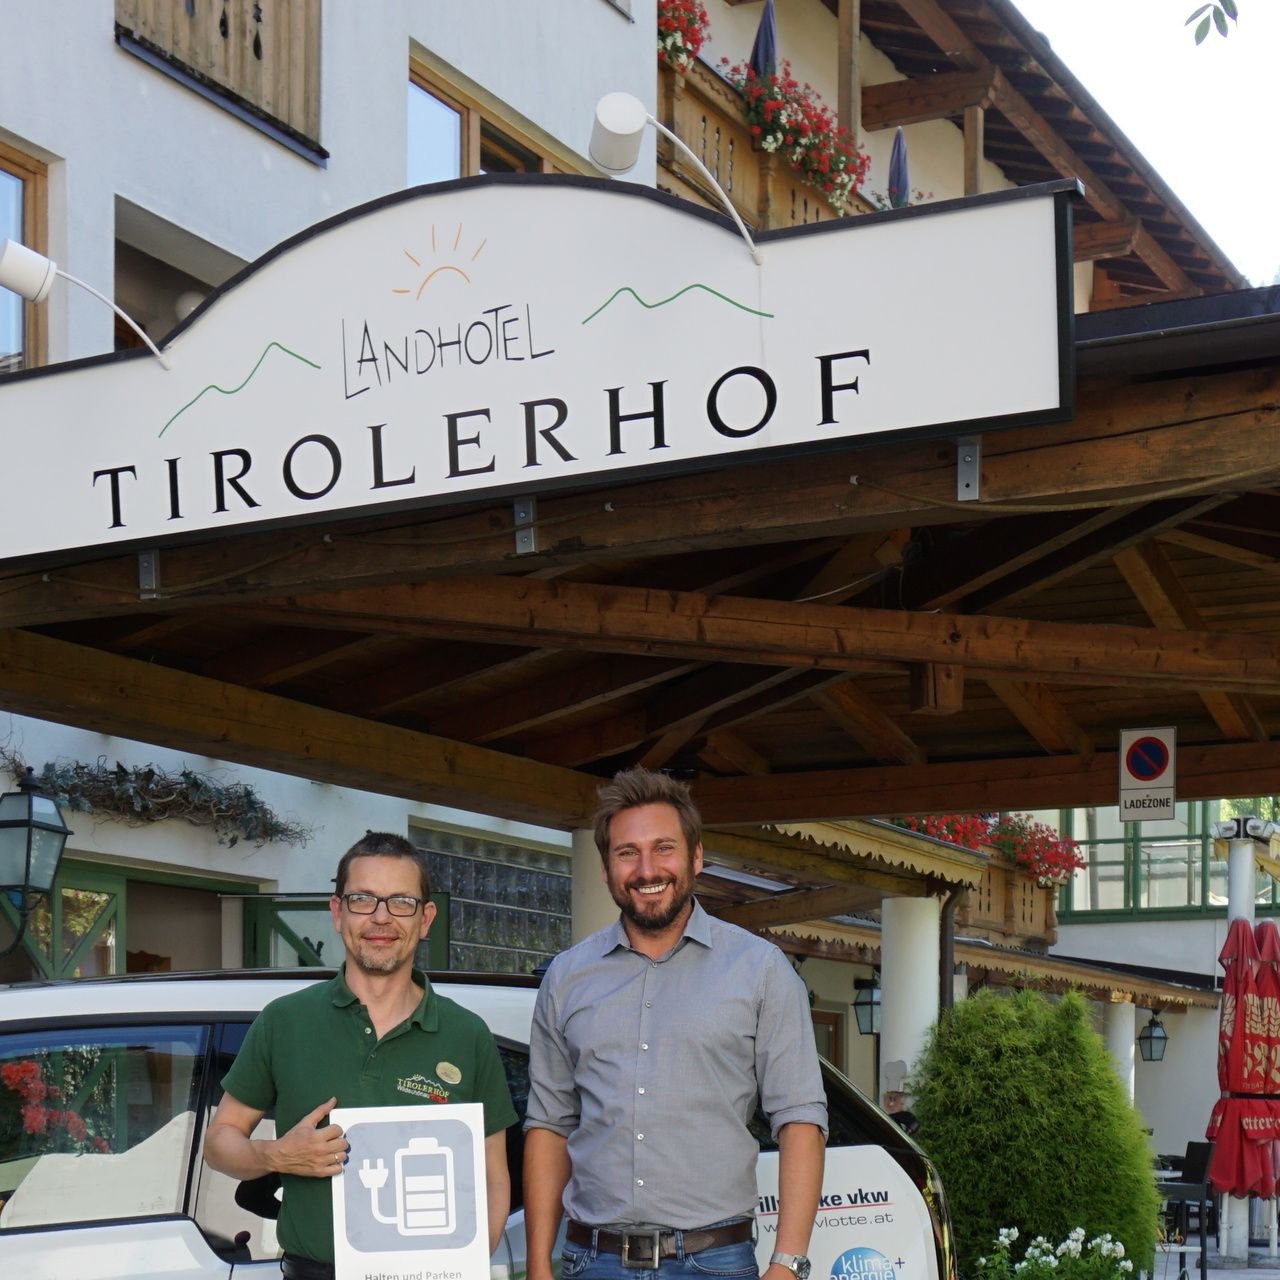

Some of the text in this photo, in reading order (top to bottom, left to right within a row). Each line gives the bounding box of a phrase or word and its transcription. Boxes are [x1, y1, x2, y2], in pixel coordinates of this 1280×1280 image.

[341, 303, 556, 400] LANDHOTEL
[91, 348, 872, 529] TIROLERHOF
[1124, 798, 1171, 809] LADEZONE
[397, 1078, 450, 1099] TIROLERHOF
[847, 1188, 889, 1205] vkw
[841, 1254, 892, 1273] klima
[402, 1272, 423, 1280] und
[426, 1271, 462, 1280] Parken
